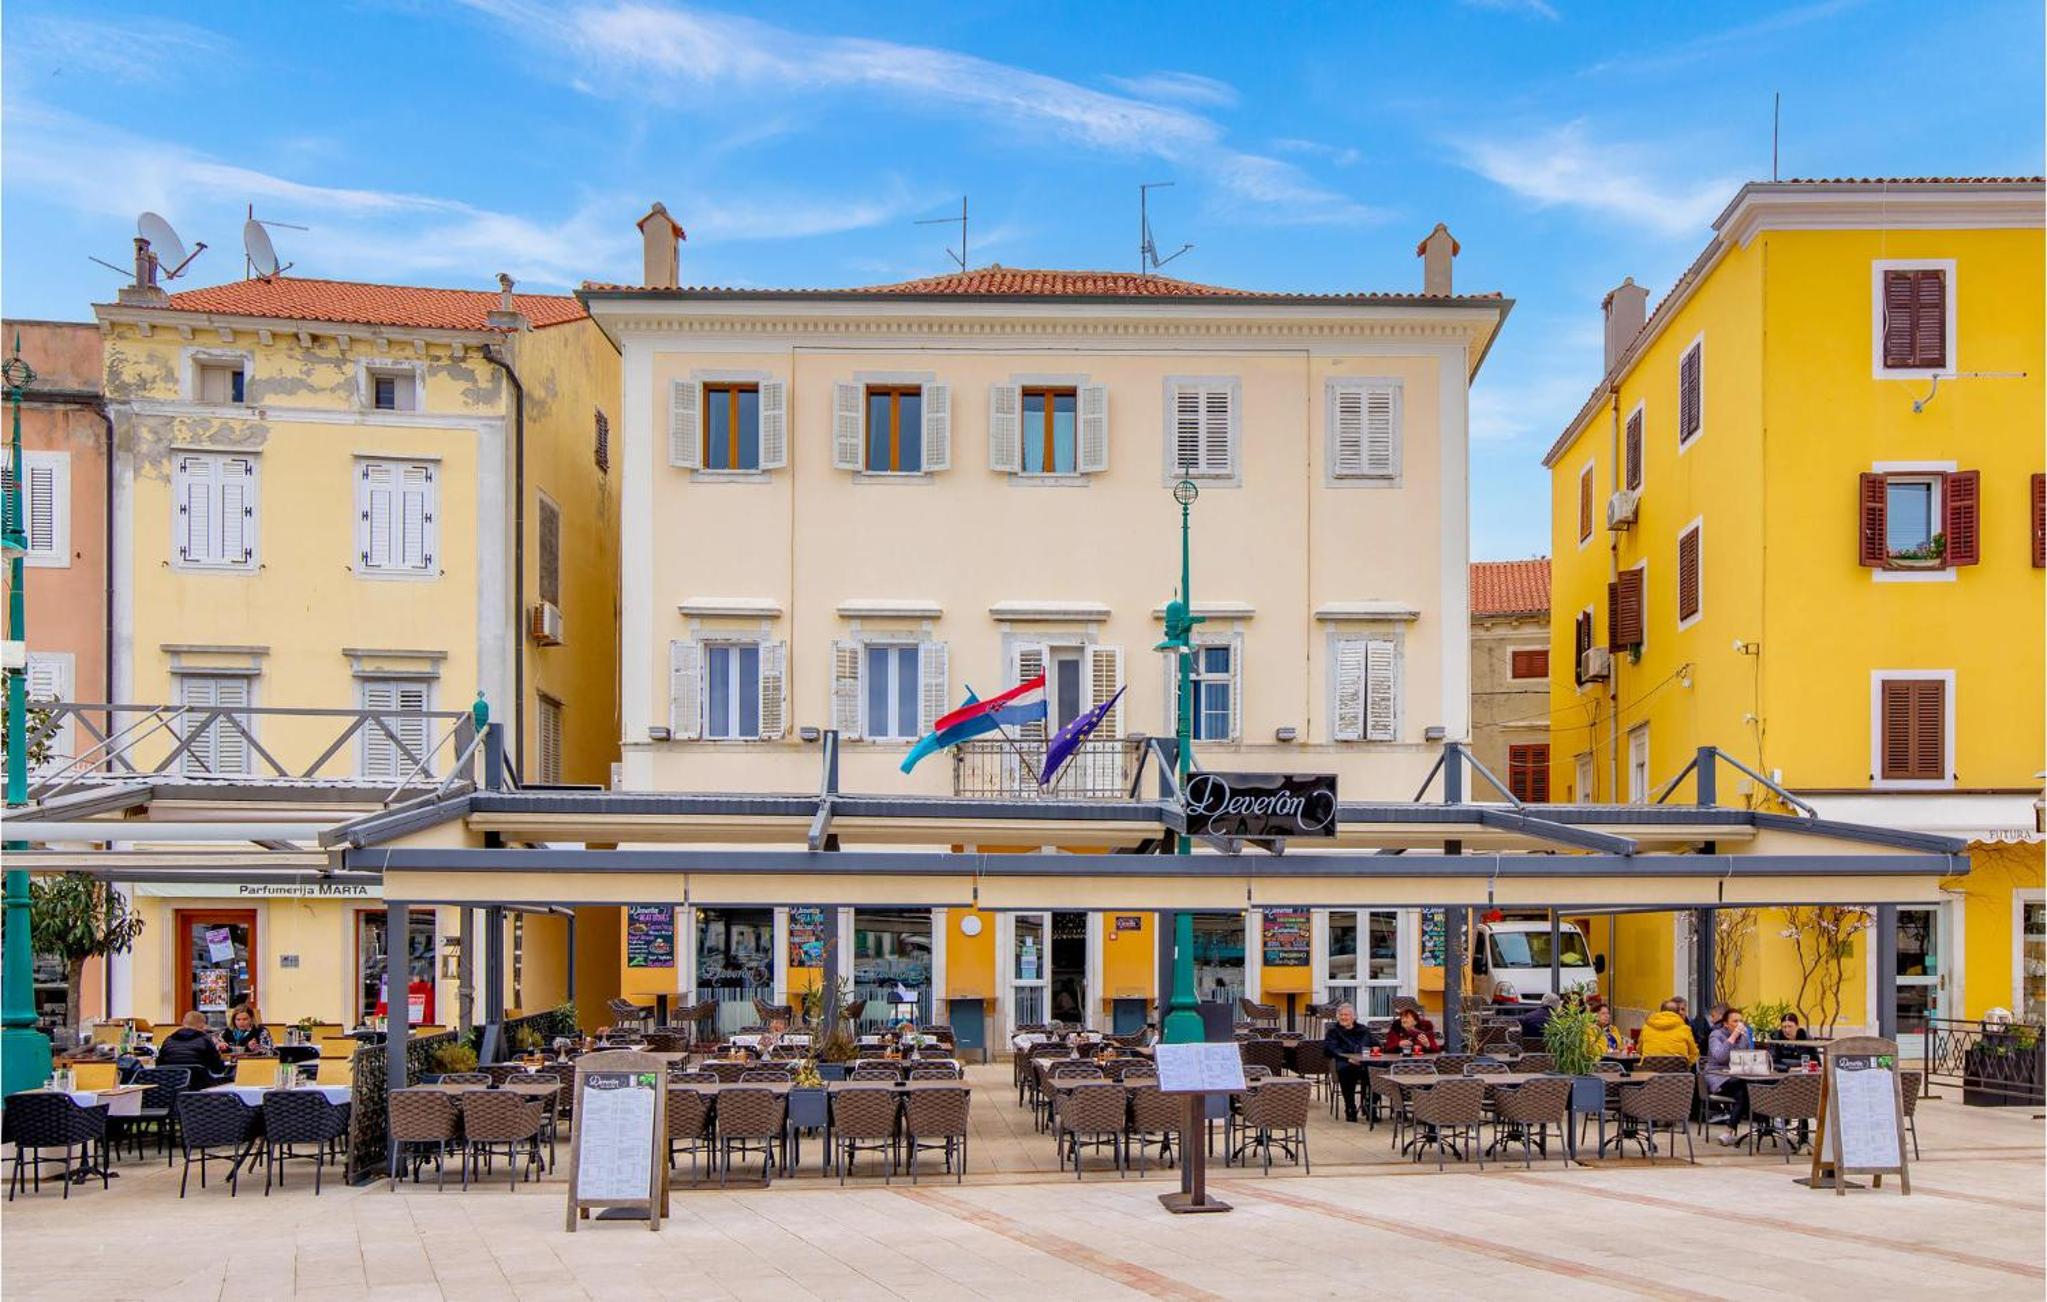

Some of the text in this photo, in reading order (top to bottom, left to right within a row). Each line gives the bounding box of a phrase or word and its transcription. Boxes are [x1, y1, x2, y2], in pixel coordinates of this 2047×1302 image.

[1187, 775, 1335, 835] Deveron
[1989, 829, 2031, 839] FUTURA
[239, 885, 368, 896] Parfumerija MARTA
